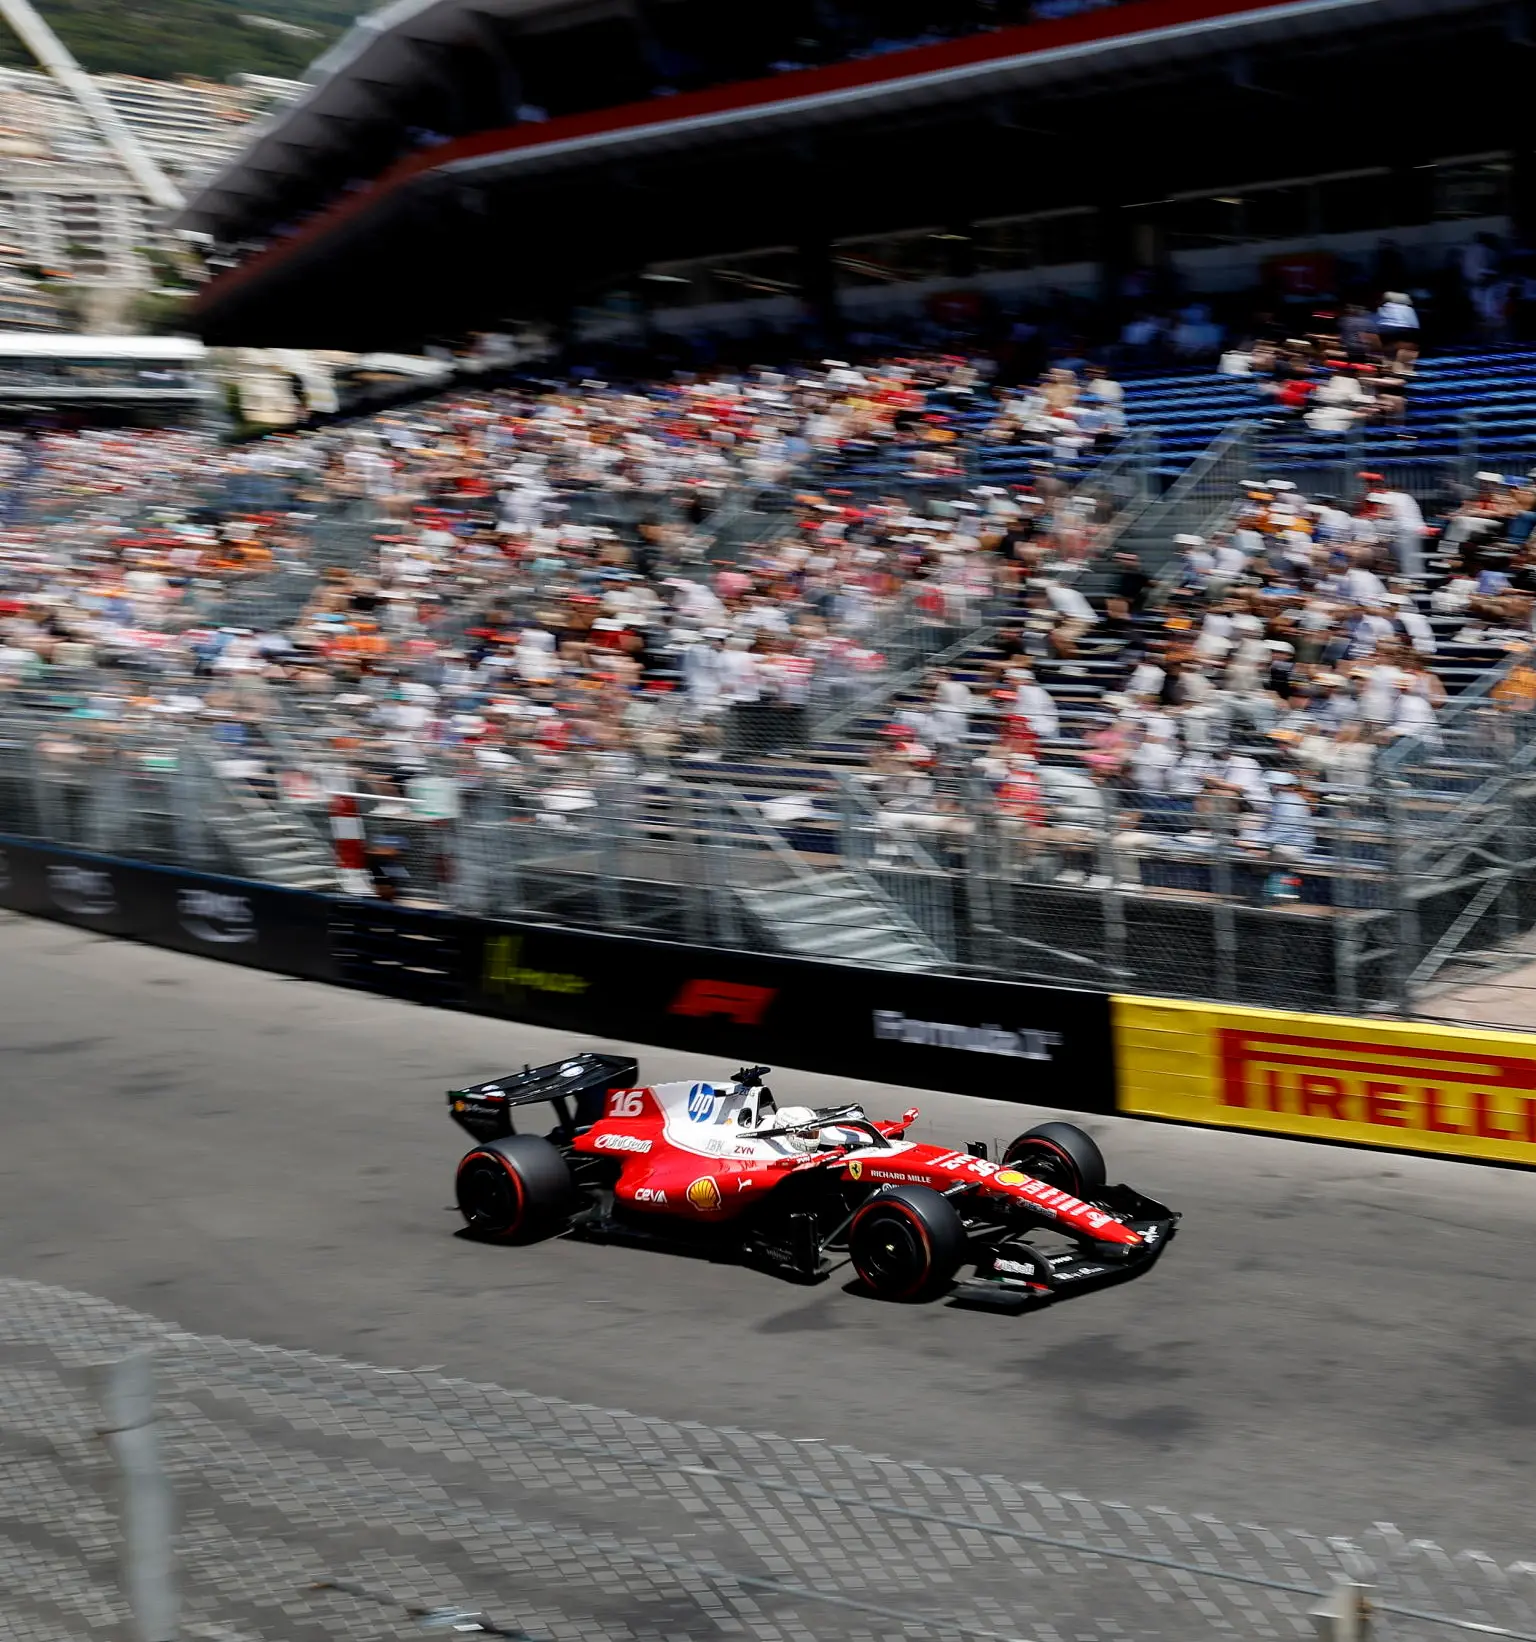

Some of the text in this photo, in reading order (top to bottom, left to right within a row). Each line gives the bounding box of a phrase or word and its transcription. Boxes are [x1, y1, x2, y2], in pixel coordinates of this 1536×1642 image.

[608, 1090, 644, 1117] 16
[870, 1169, 932, 1184] RICHARD MILLE
